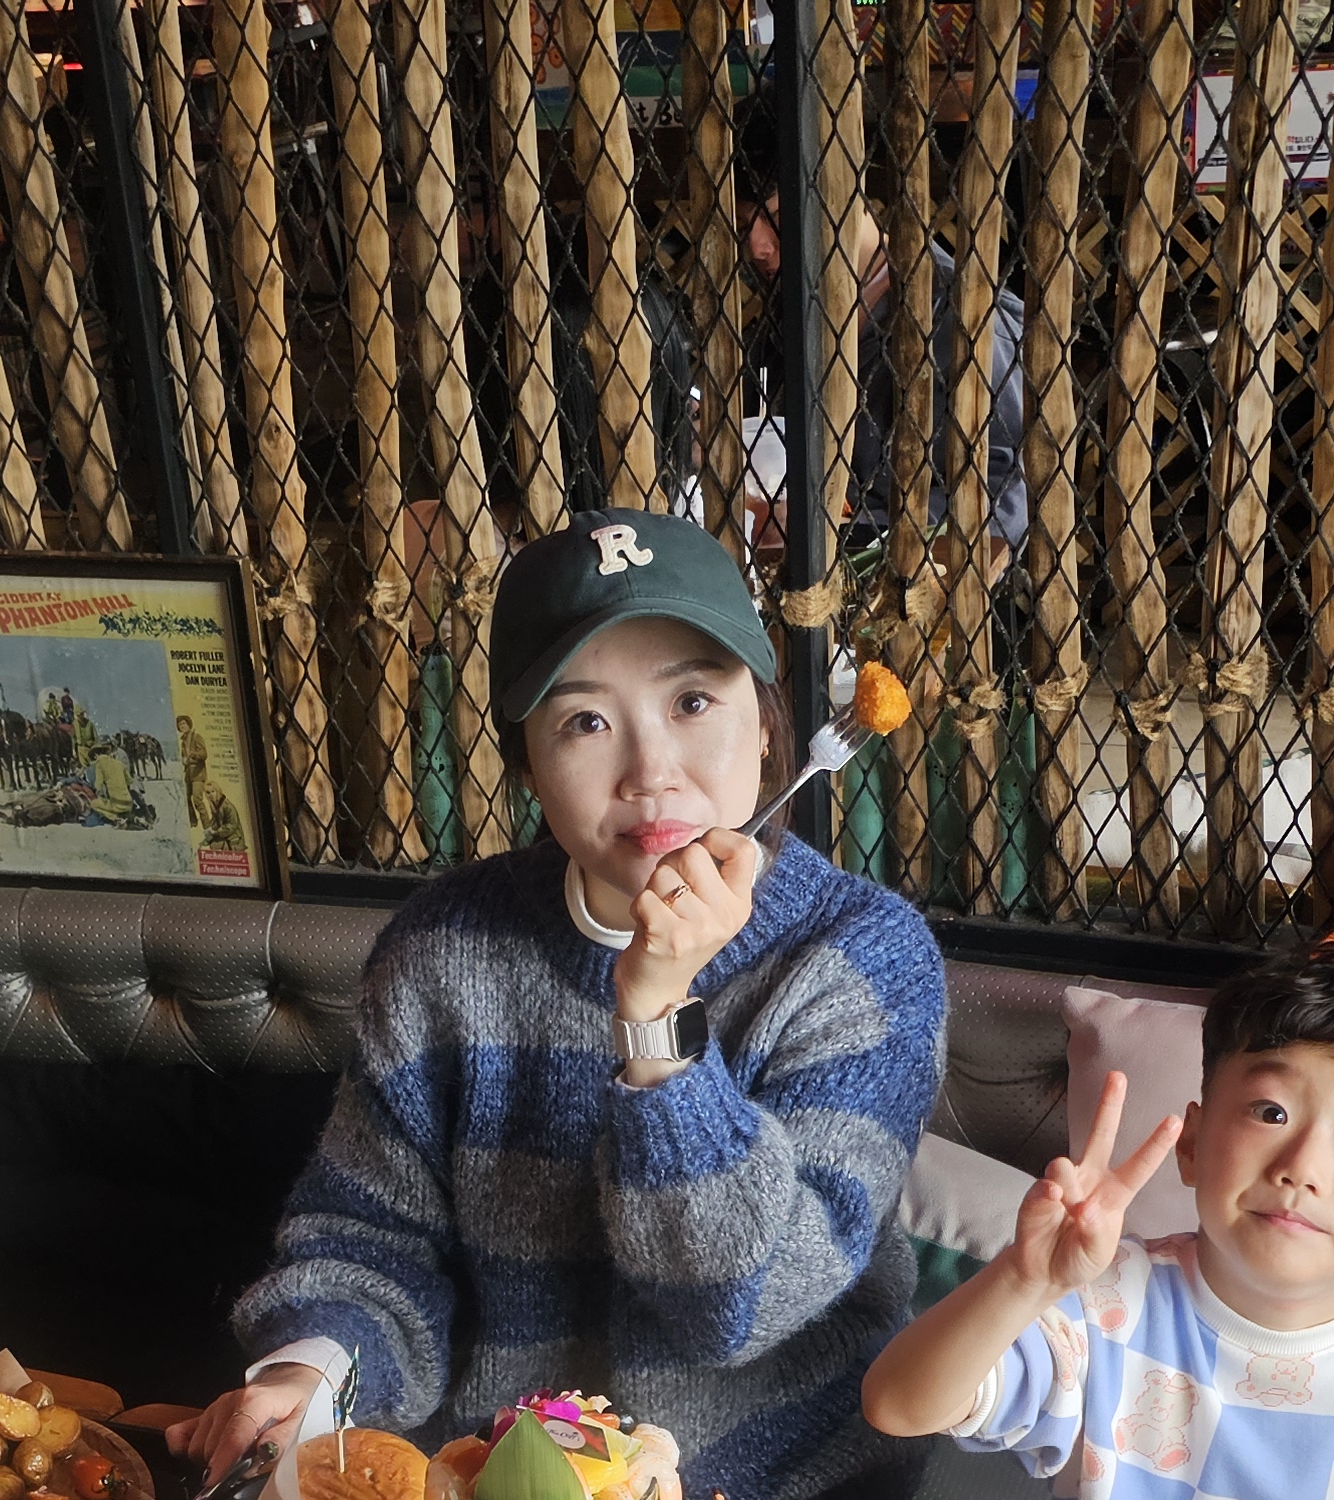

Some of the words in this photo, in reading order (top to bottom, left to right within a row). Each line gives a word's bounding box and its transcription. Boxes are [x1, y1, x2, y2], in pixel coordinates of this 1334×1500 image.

[590, 524, 654, 576] R
[91, 593, 137, 616] HILL
[170, 650, 197, 661] ROBERT
[199, 651, 225, 662] FULLER
[178, 663, 207, 674] JOCELYN
[208, 664, 226, 675] LANE
[185, 675, 200, 686] DAN
[200, 677, 227, 688] DURYEA
